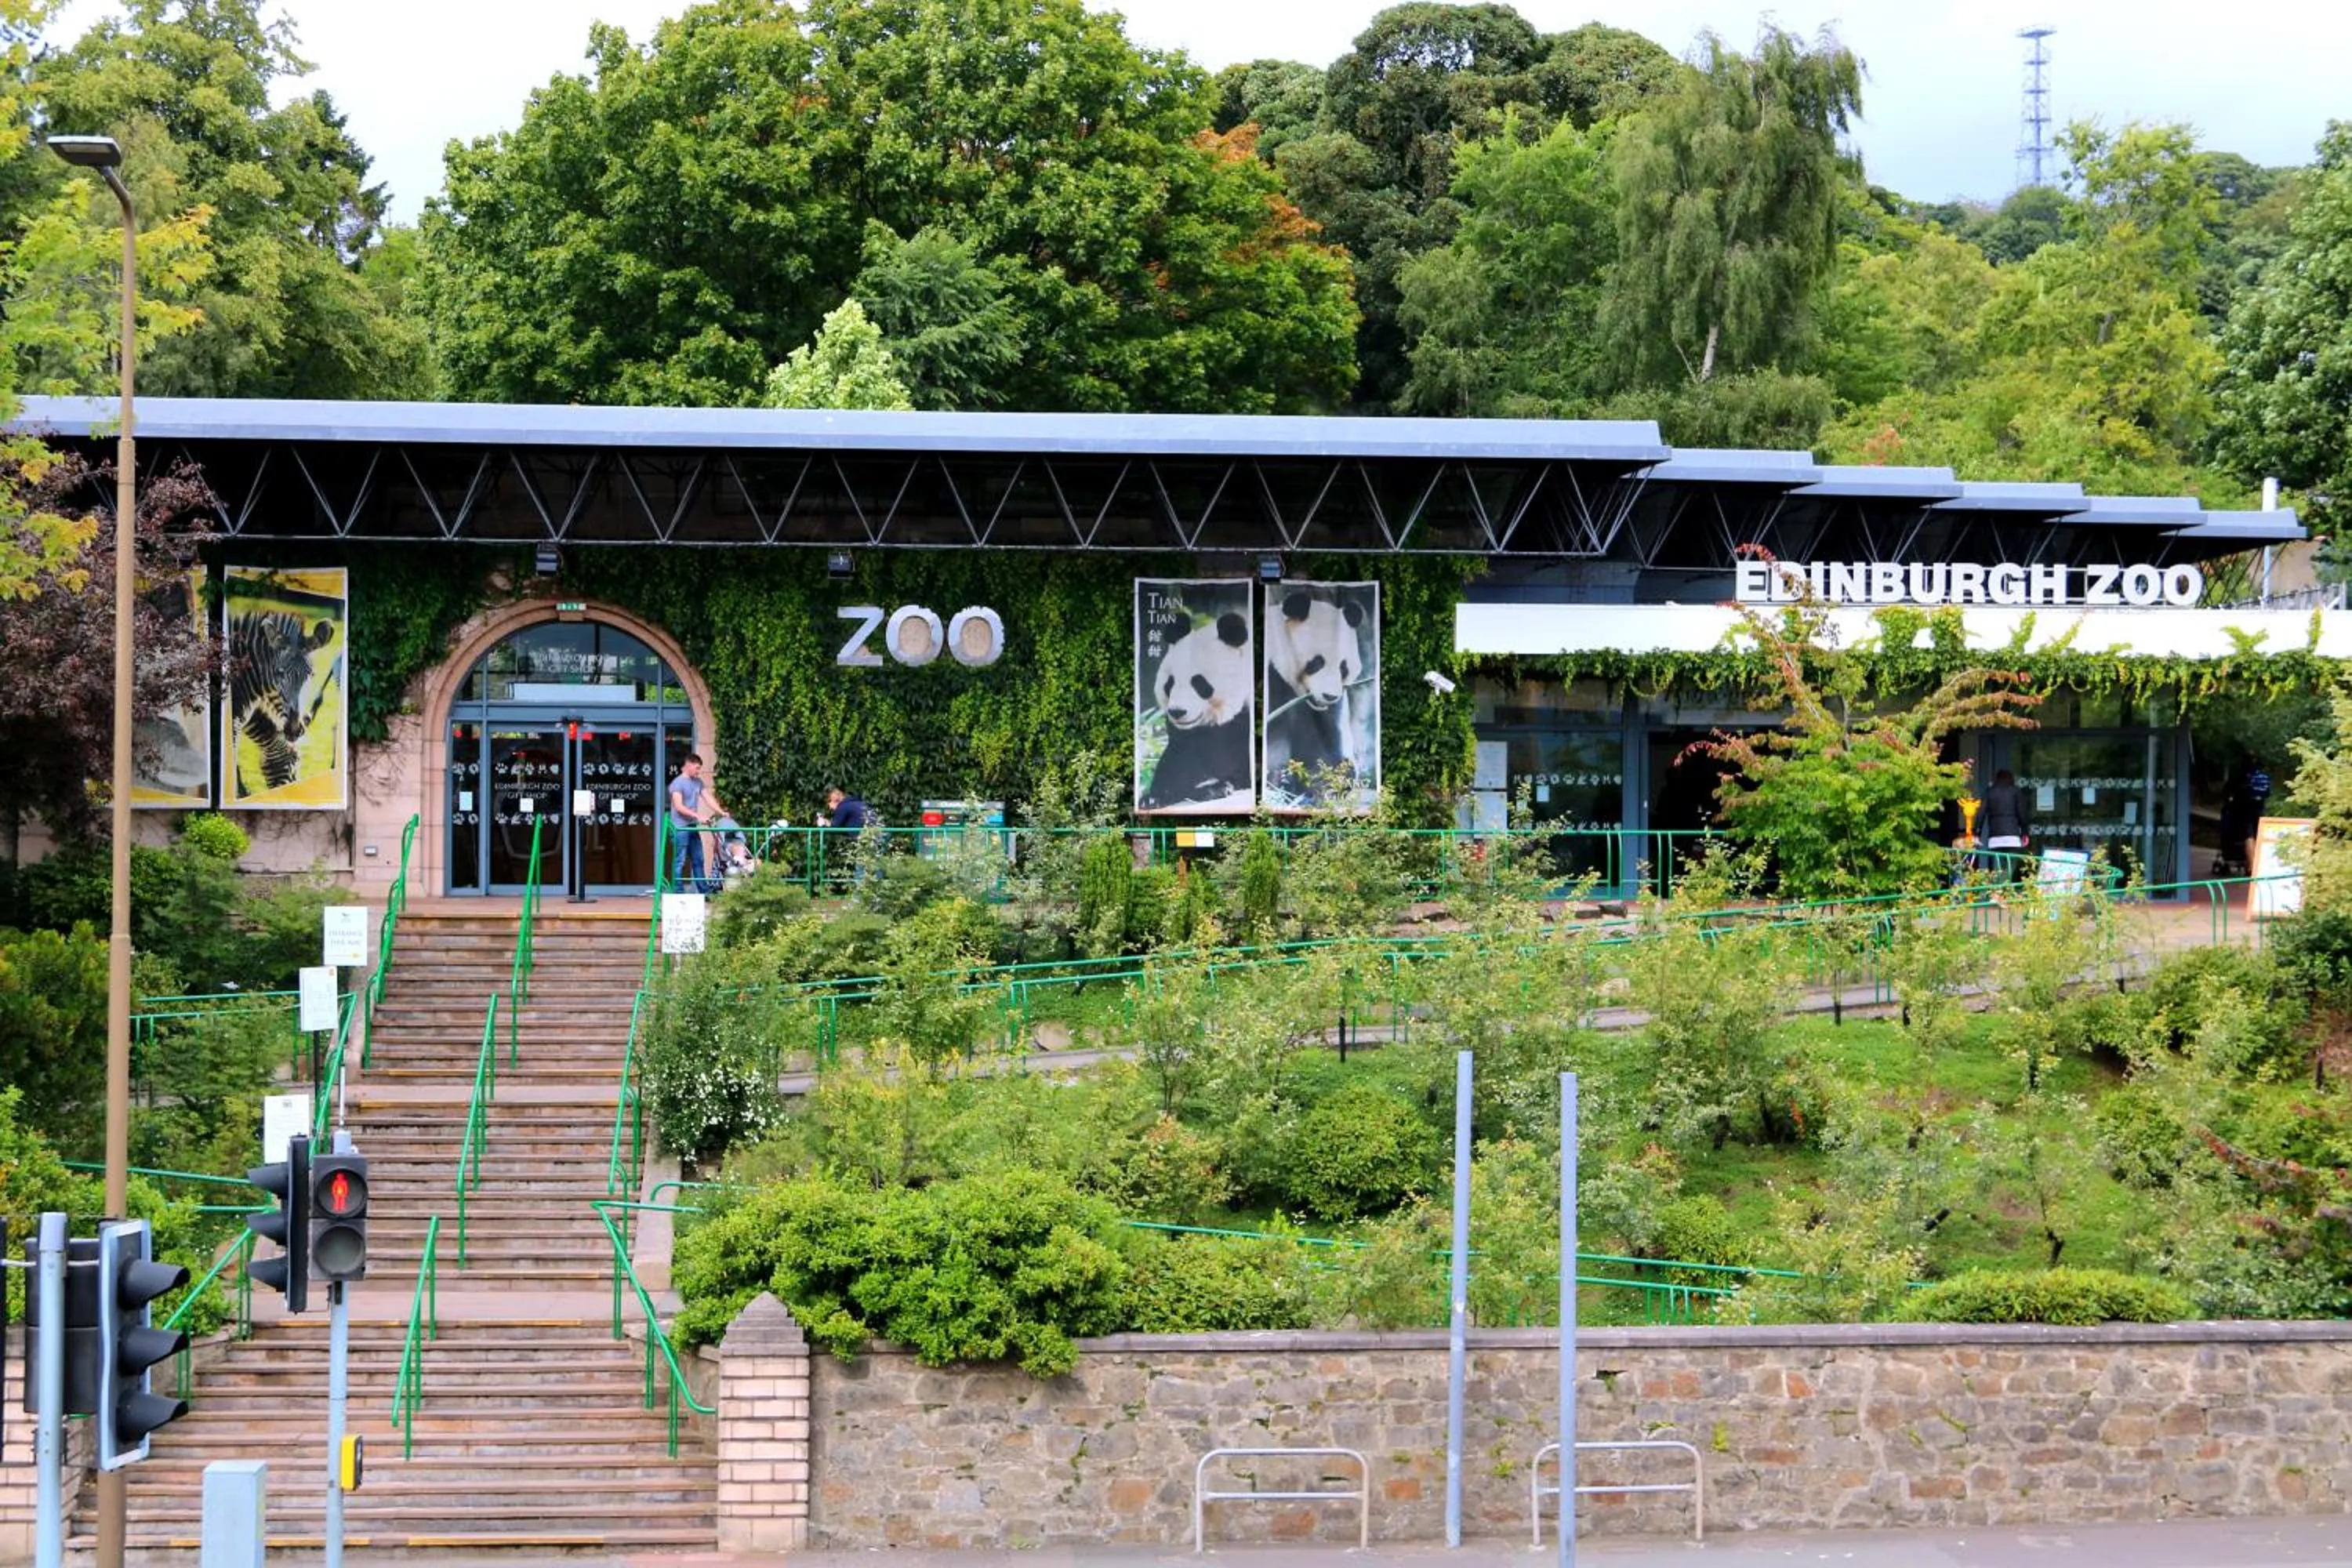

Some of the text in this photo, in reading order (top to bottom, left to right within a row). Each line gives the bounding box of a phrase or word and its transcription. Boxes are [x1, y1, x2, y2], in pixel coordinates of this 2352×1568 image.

[1736, 561, 2205, 605] EDINBURGH ZOO
[837, 604, 1004, 666] ZOO
